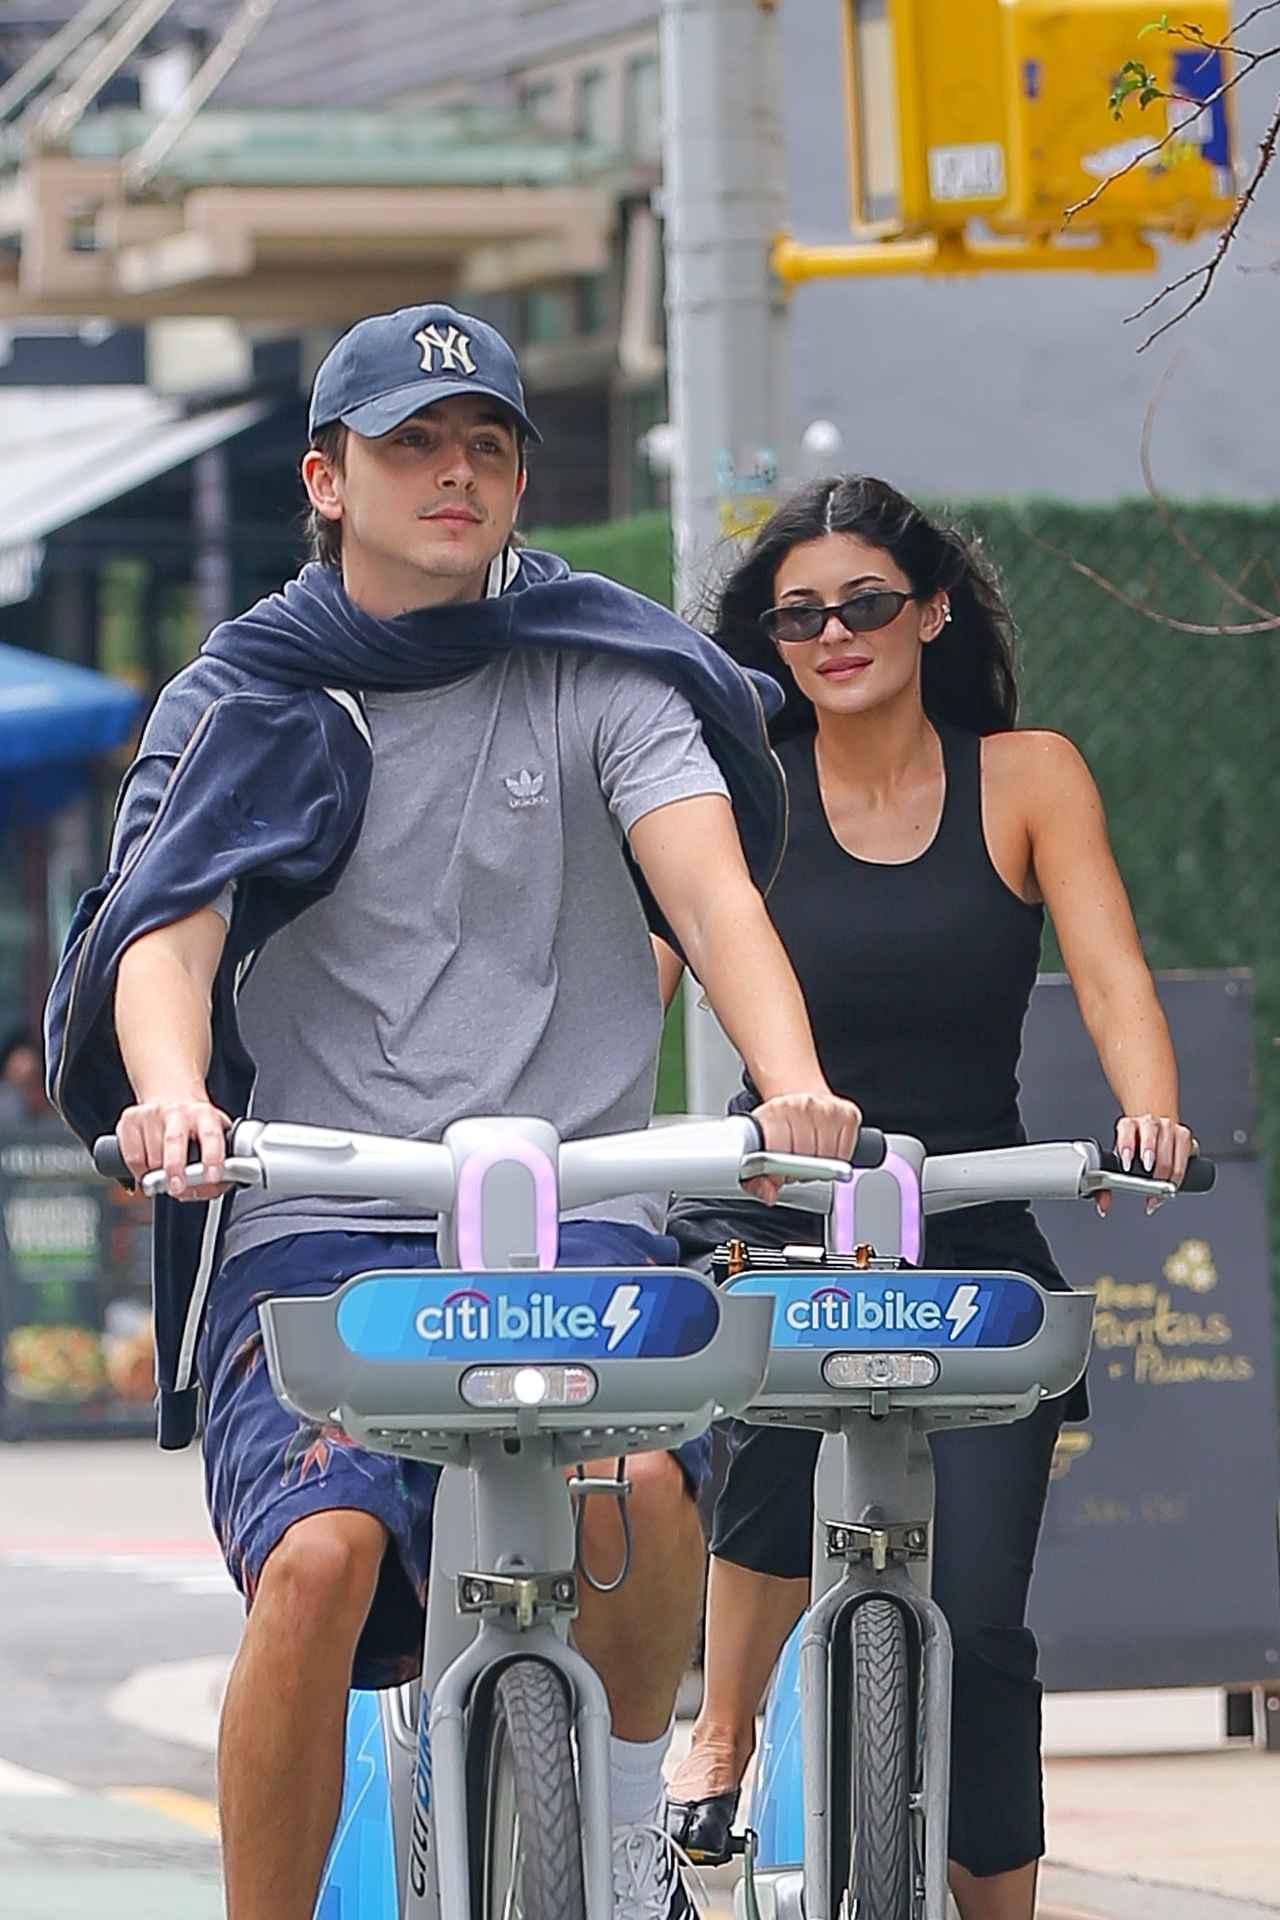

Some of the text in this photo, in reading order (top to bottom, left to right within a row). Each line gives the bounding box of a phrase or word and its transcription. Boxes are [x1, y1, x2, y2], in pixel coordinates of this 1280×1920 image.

[414, 323, 477, 376] NY
[415, 1288, 598, 1341] citi bike
[786, 1285, 942, 1330] citi bike
